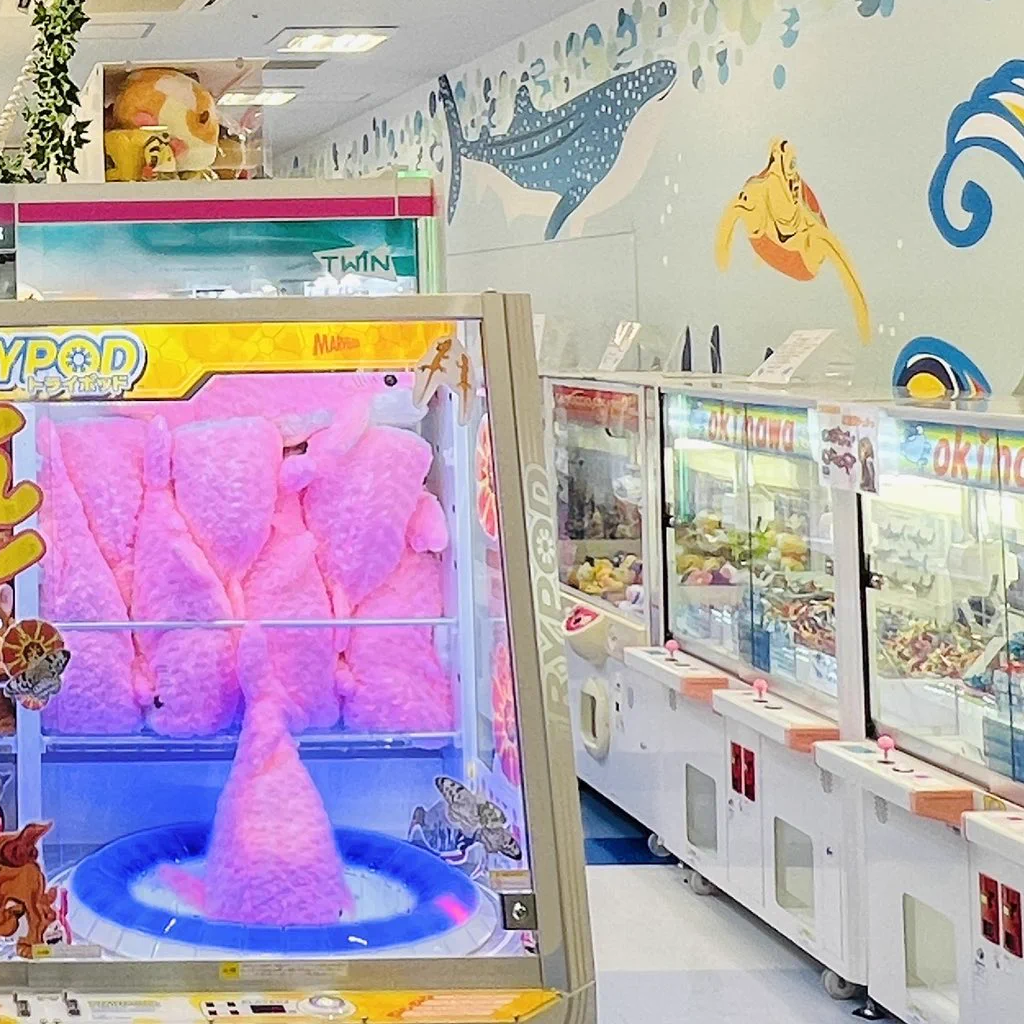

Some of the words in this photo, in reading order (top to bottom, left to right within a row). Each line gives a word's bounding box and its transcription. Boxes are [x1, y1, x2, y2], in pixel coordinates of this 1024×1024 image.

[321, 250, 390, 273] TWIN
[27, 374, 128, 397] トライポッド
[525, 463, 570, 733] RYPOD
